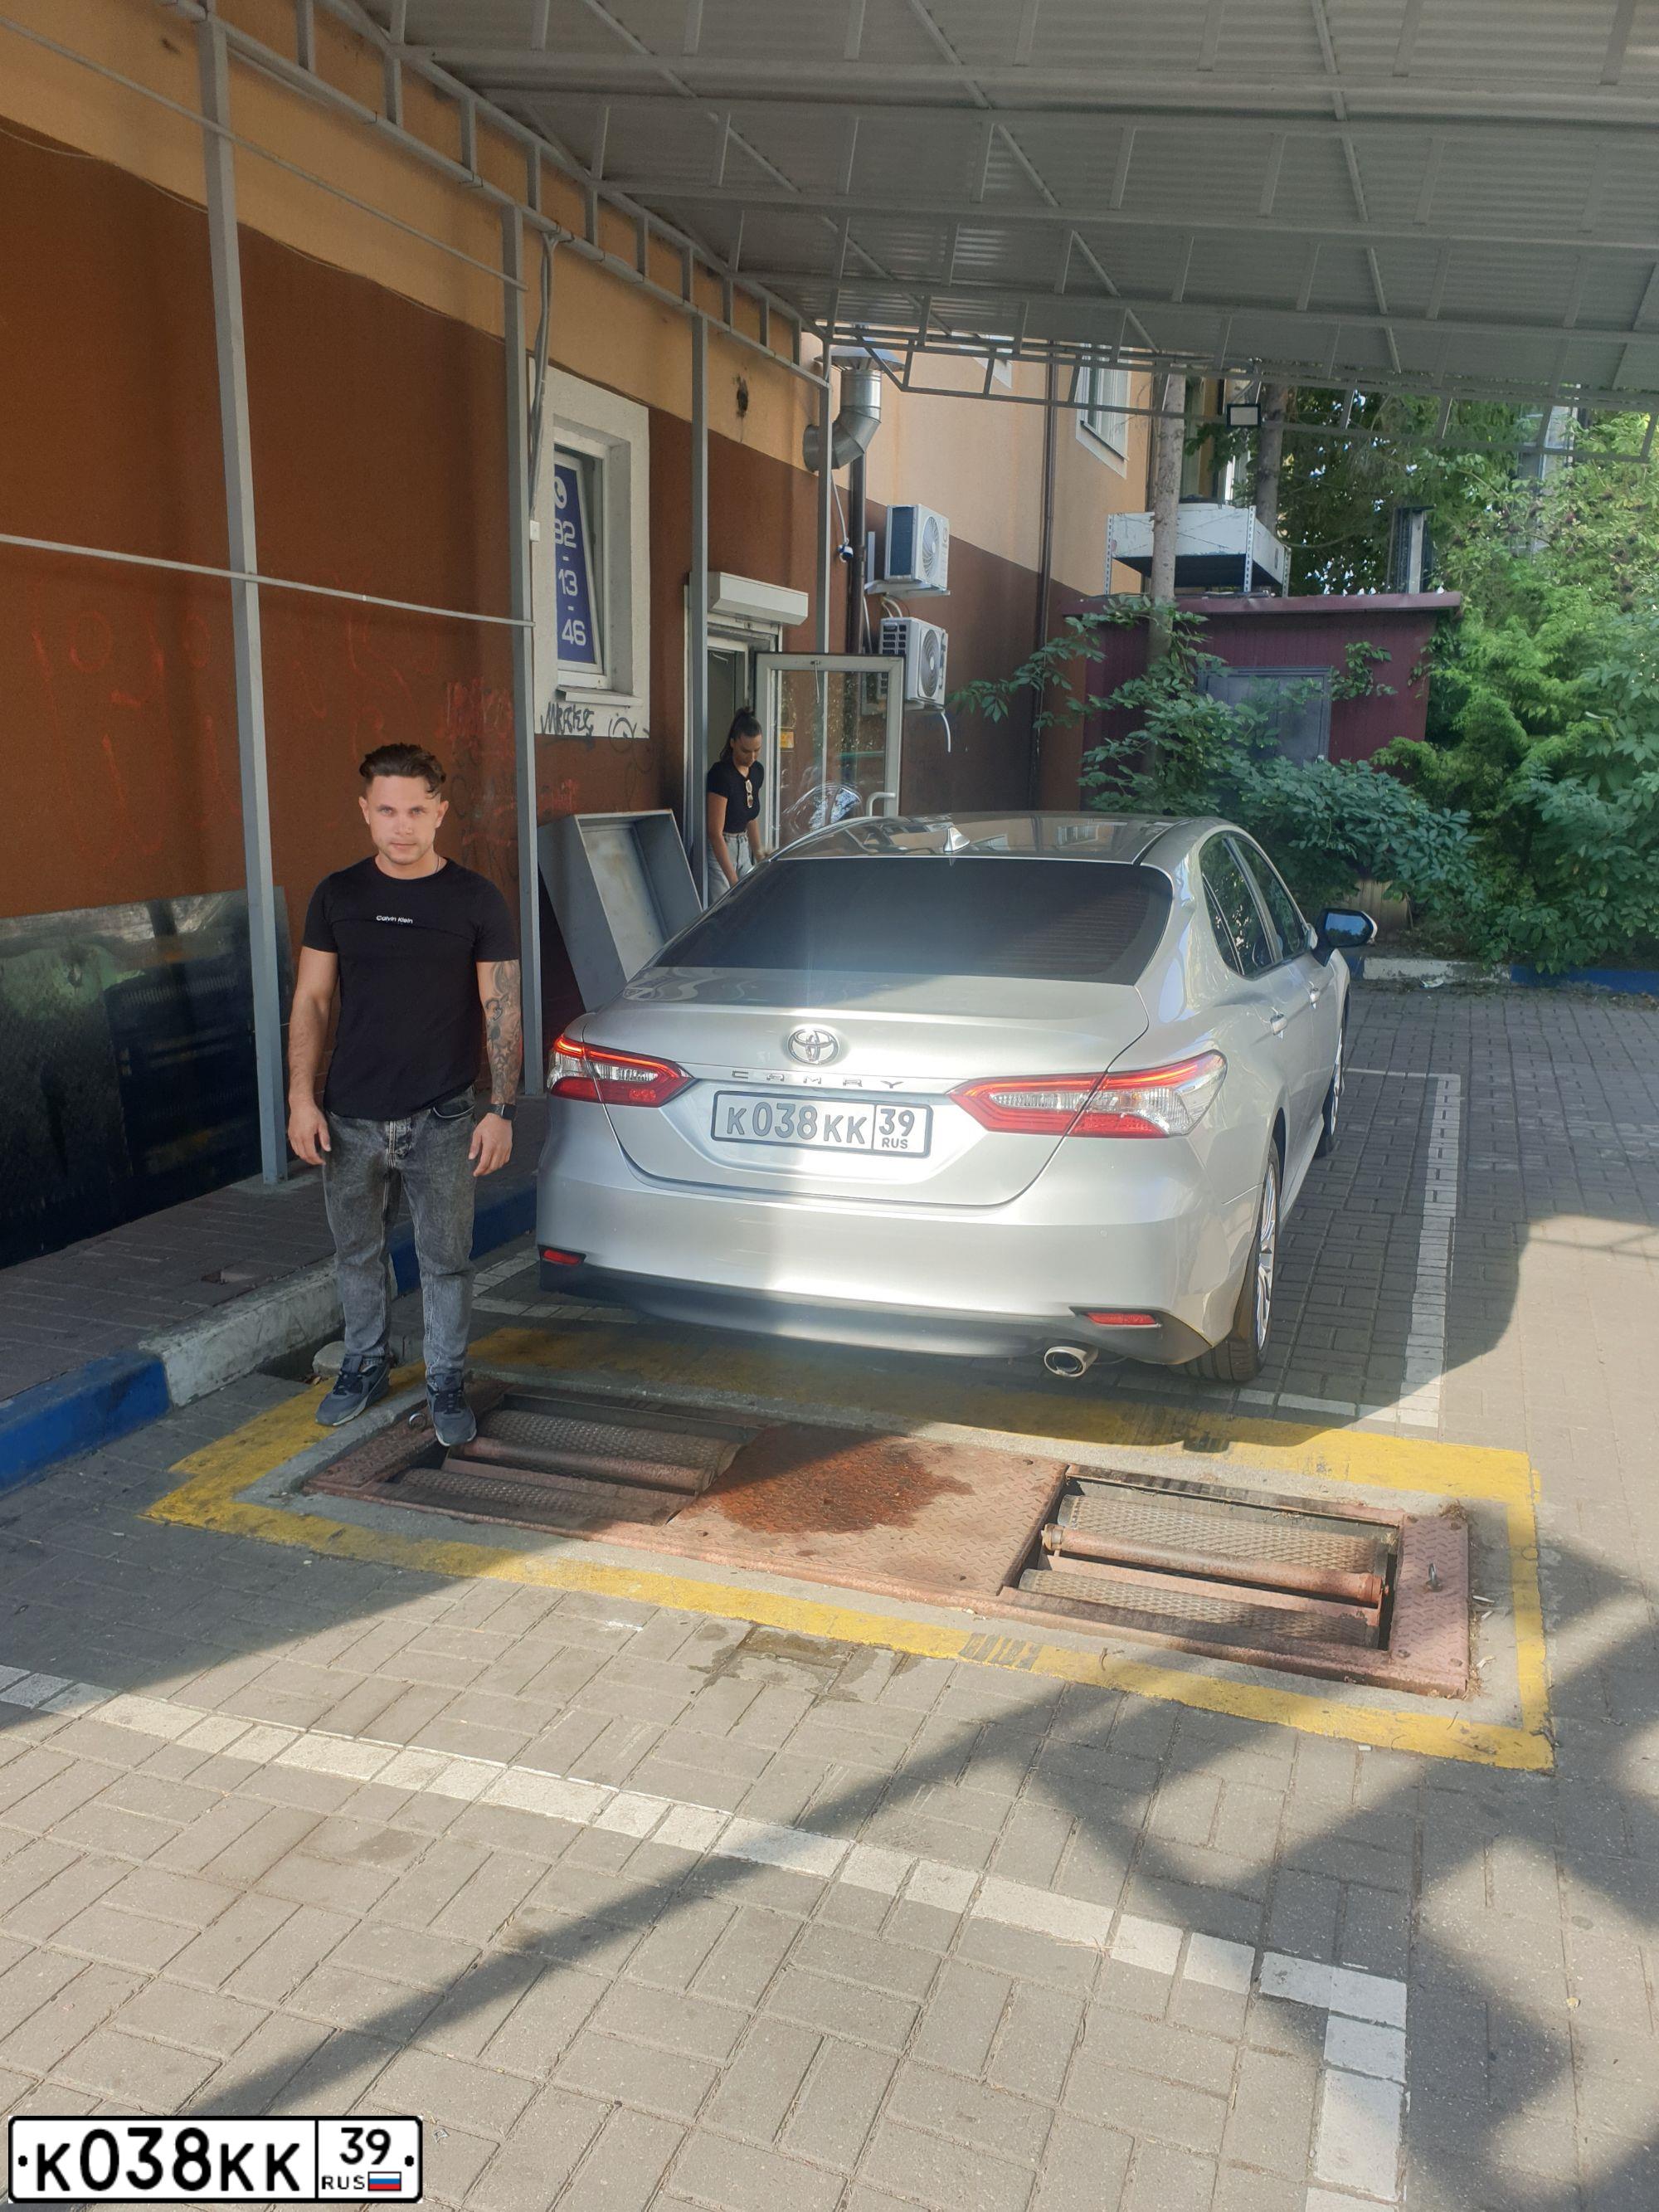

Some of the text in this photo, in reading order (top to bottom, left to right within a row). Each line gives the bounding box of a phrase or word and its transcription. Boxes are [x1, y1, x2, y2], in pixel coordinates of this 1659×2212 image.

[558, 568, 578, 596] 13
[562, 618, 586, 646] 46
[732, 1070, 903, 1089] CAMRY
[879, 1108, 915, 1136] 39
[881, 1138, 908, 1149] RUS
